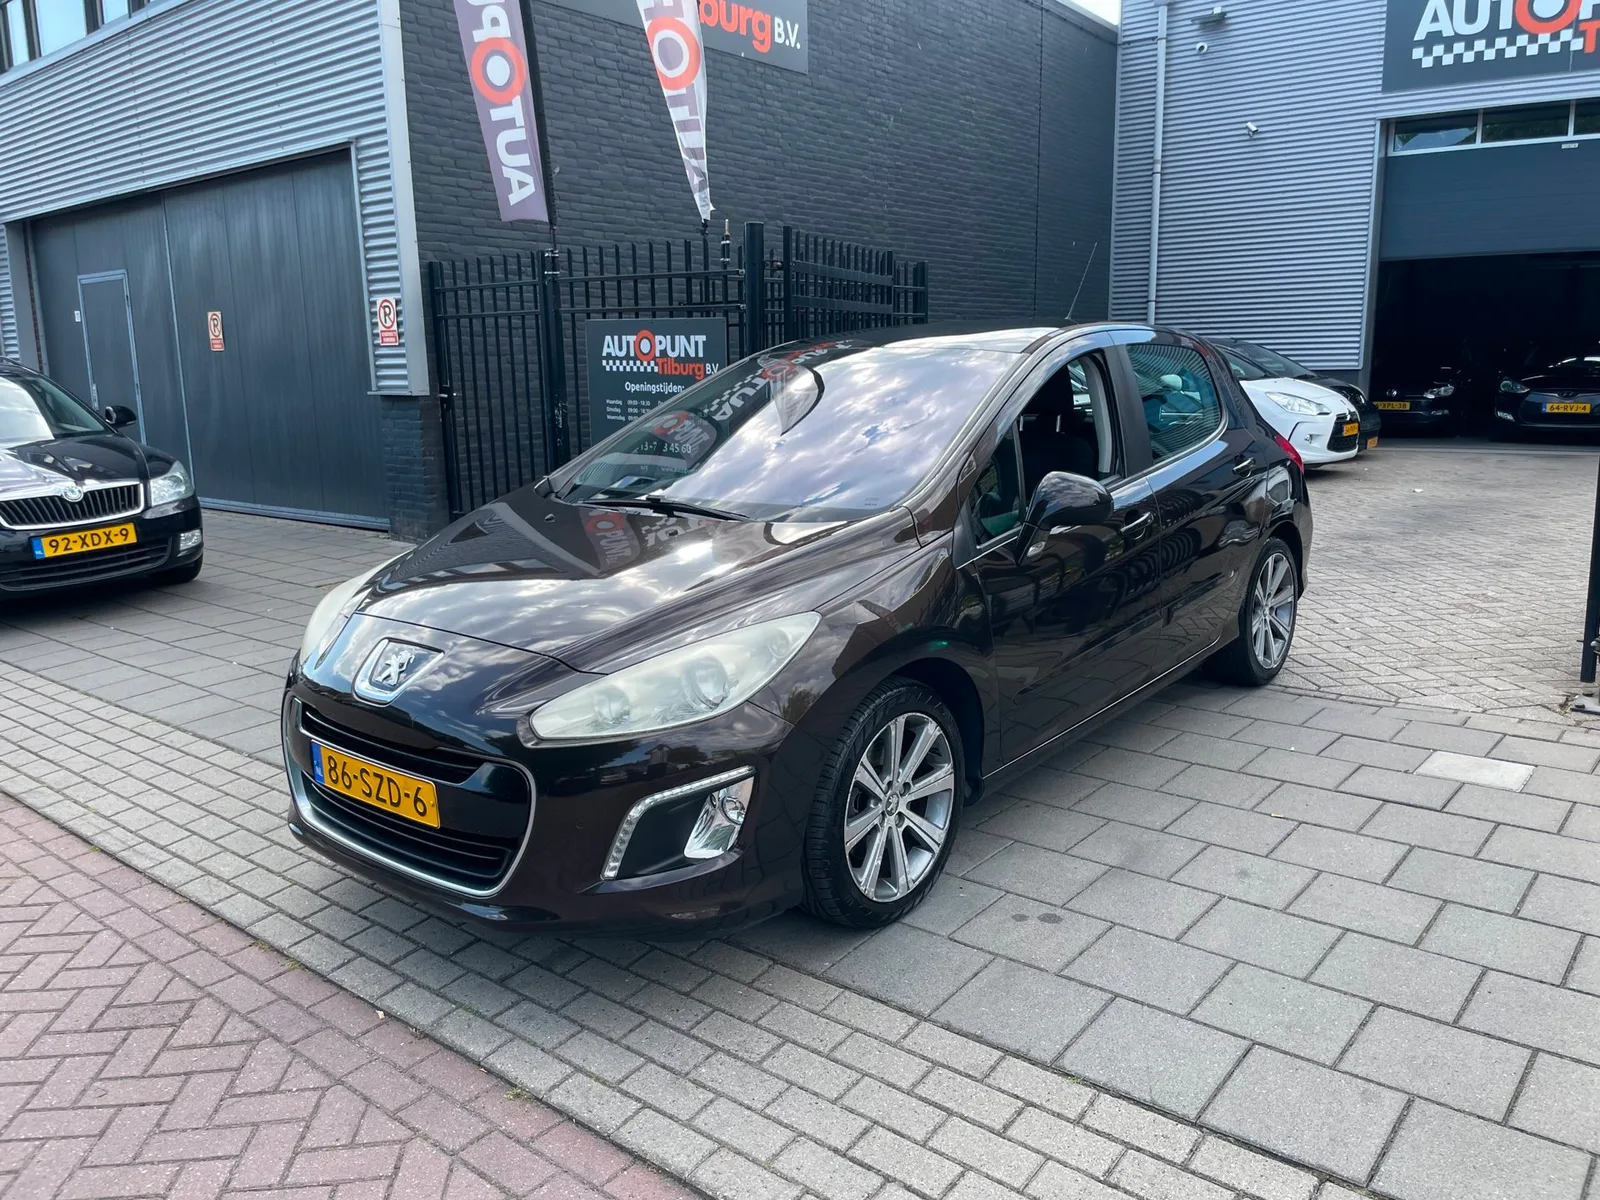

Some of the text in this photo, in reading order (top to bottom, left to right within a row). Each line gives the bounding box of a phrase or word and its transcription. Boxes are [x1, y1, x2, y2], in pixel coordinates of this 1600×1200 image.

[699, 0, 801, 53] burg B.V.
[1578, 20, 1600, 54] T
[601, 329, 707, 362] AUTOPUNT
[656, 357, 704, 380] Tilburg
[1549, 404, 1587, 412] 64-RVJ-4
[48, 527, 129, 554] 92-XDX-9
[327, 755, 428, 817] 86-SZD-6
